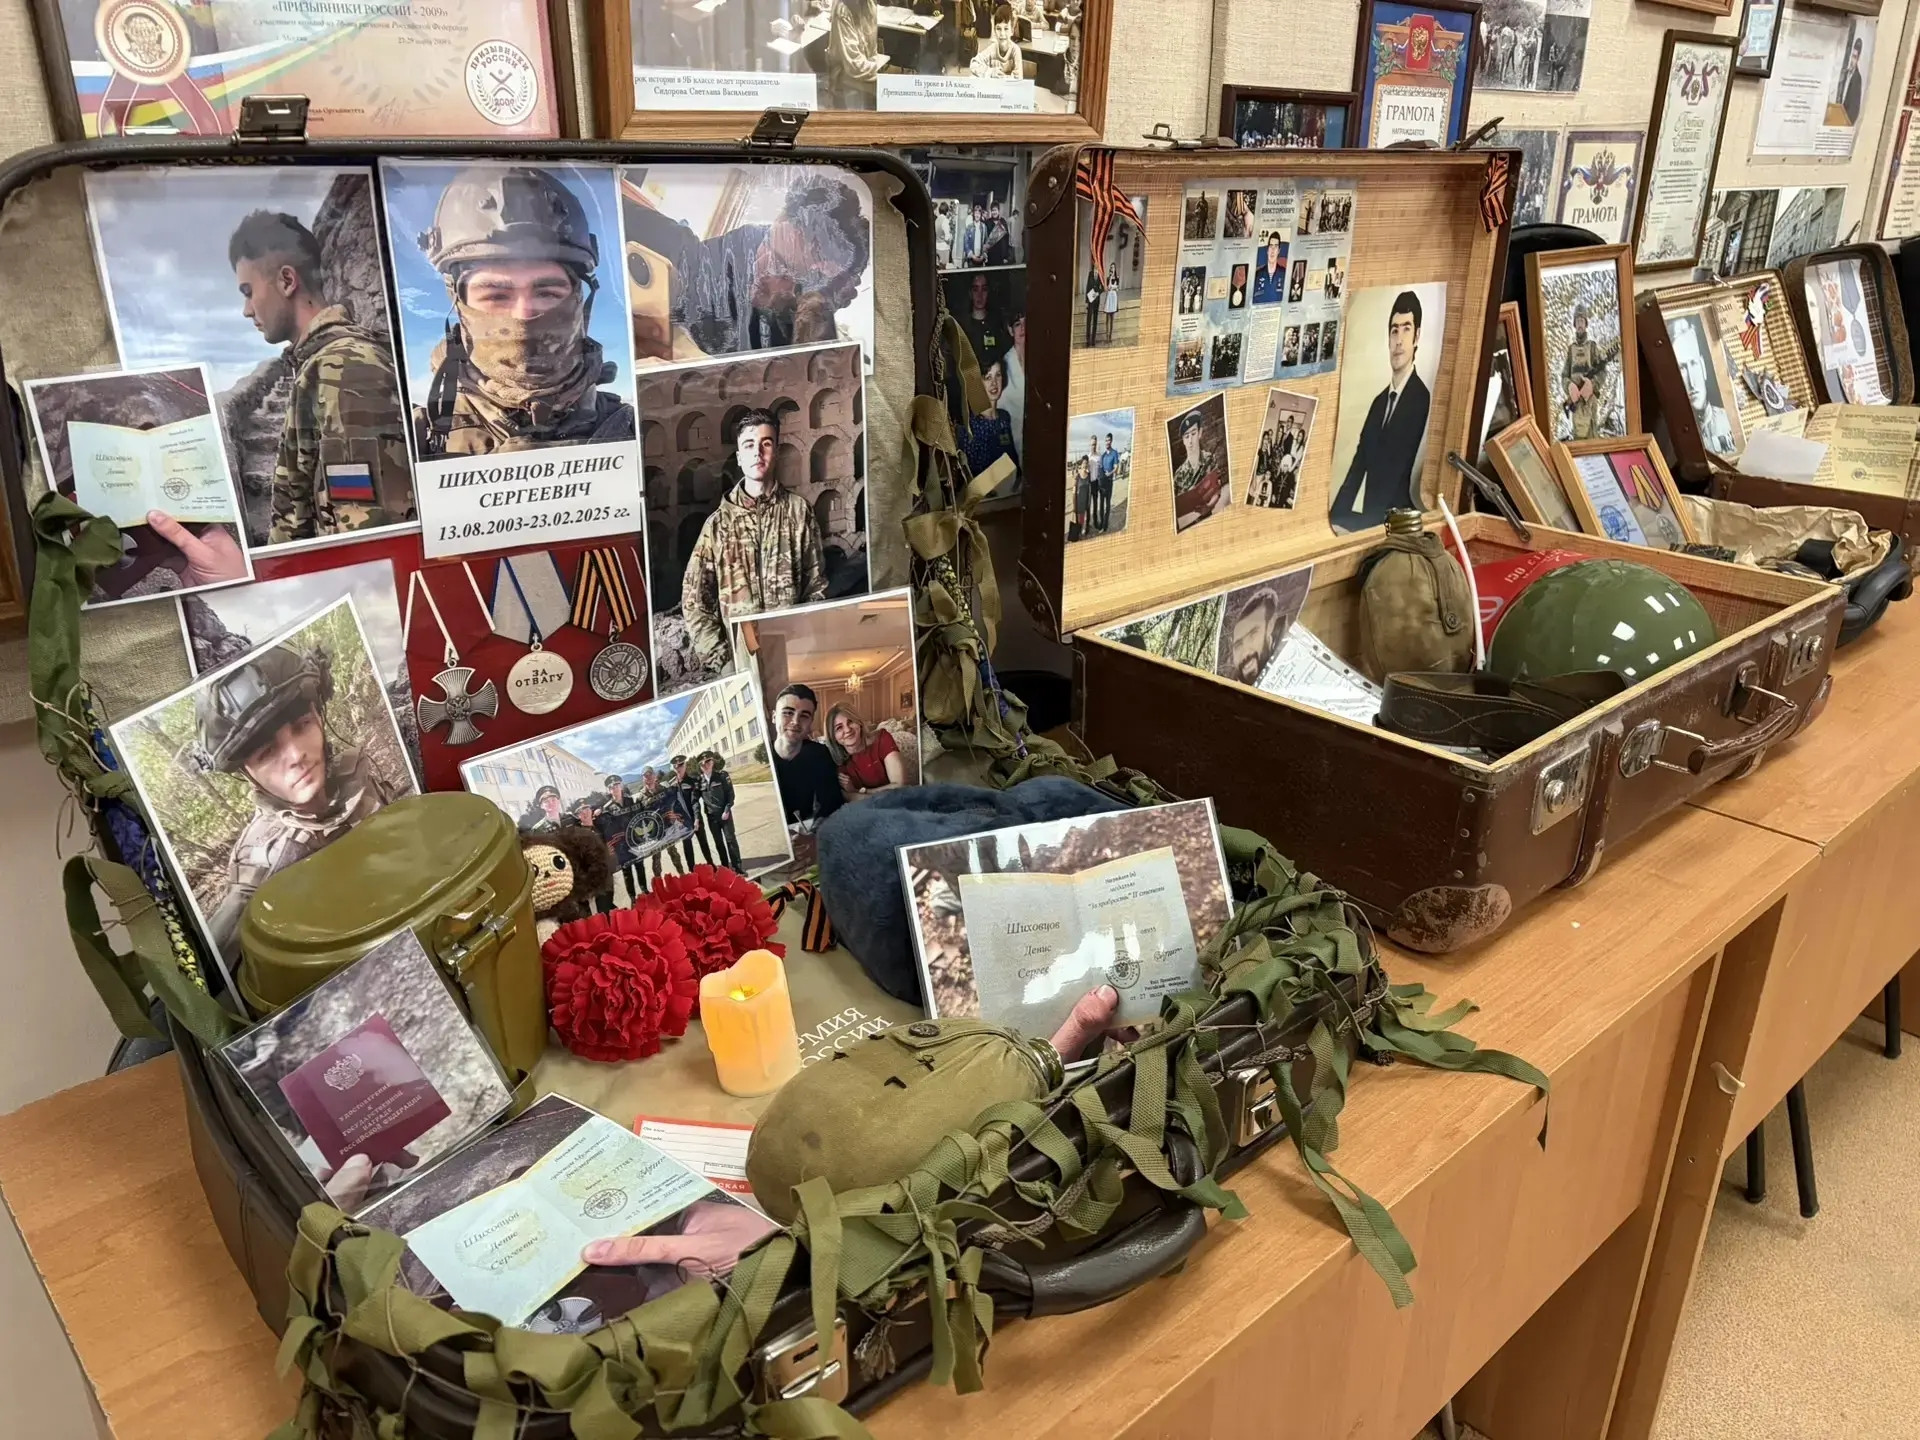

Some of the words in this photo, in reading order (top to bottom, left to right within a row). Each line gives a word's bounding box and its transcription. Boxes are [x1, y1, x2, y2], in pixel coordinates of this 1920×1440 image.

[272, 0, 362, 15] «ПРИЗЫВНИКИ
[364, 4, 411, 16] РОССИИ
[420, 6, 449, 17] 2009»
[391, 22, 431, 31] Российской
[470, 45, 529, 71] ПРИЗЫВНИКИ
[481, 54, 518, 69] РОССИИ
[648, 76, 676, 84] истории
[735, 79, 780, 87] преподаватель
[914, 79, 923, 87] На
[923, 81, 940, 89] уроке
[653, 86, 688, 97] Сидорова
[689, 87, 721, 96] Светлана
[722, 88, 759, 97] Васильевна
[882, 88, 924, 98] Преподаватель
[955, 90, 976, 98] Любовь
[493, 98, 514, 106] 2009
[1386, 105, 1435, 122] ГРАМОТА
[1571, 206, 1618, 225] ГРАМОТА
[438, 462, 555, 489] ШИХОВЦОВ
[558, 455, 625, 478] ДЕНИС
[479, 481, 592, 508] СЕРГЕЕВИЧ
[438, 505, 611, 541] 13.08.2003-23.02.2025
[515, 672, 564, 687] ОТВАГУ
[532, 668, 548, 677] ЗА
[1006, 921, 1060, 935] Шиховцов
[1023, 945, 1052, 957] Денис
[338, 1083, 392, 1122] УДОСТОВЕРЕНИЕ
[342, 1089, 404, 1137] ГОСУДАРСТВЕННОЙ
[362, 1107, 393, 1131] НАГРАДЕ
[339, 1123, 382, 1155] РОССИЙСКОЙ
[382, 1094, 422, 1125] ФЕДЕРАЦИИ
[463, 1212, 520, 1248] Шиховцов
[490, 1231, 519, 1253] Денис
[490, 1236, 539, 1270] Сергеевич
